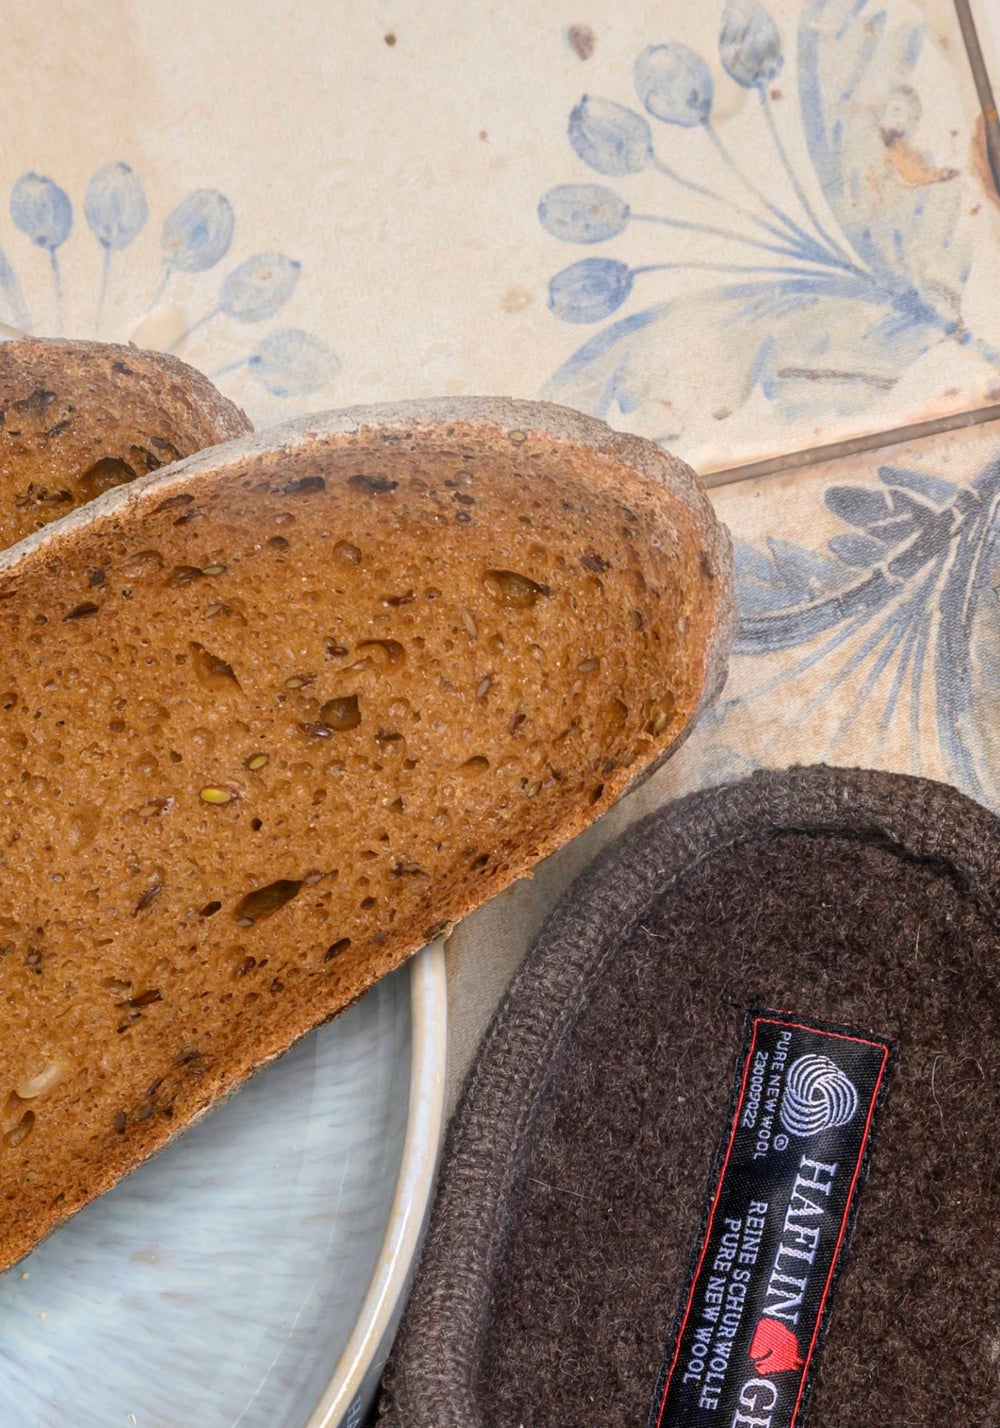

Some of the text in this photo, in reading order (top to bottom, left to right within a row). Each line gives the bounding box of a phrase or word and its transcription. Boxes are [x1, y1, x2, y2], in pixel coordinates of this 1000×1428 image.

[742, 1050, 769, 1129] 230009022
[753, 1030, 793, 1161] PURE NEW WOOL
[682, 1216, 743, 1385] PURE NEW WOOL
[699, 1199, 770, 1411] REINE SCHURWOLLE
